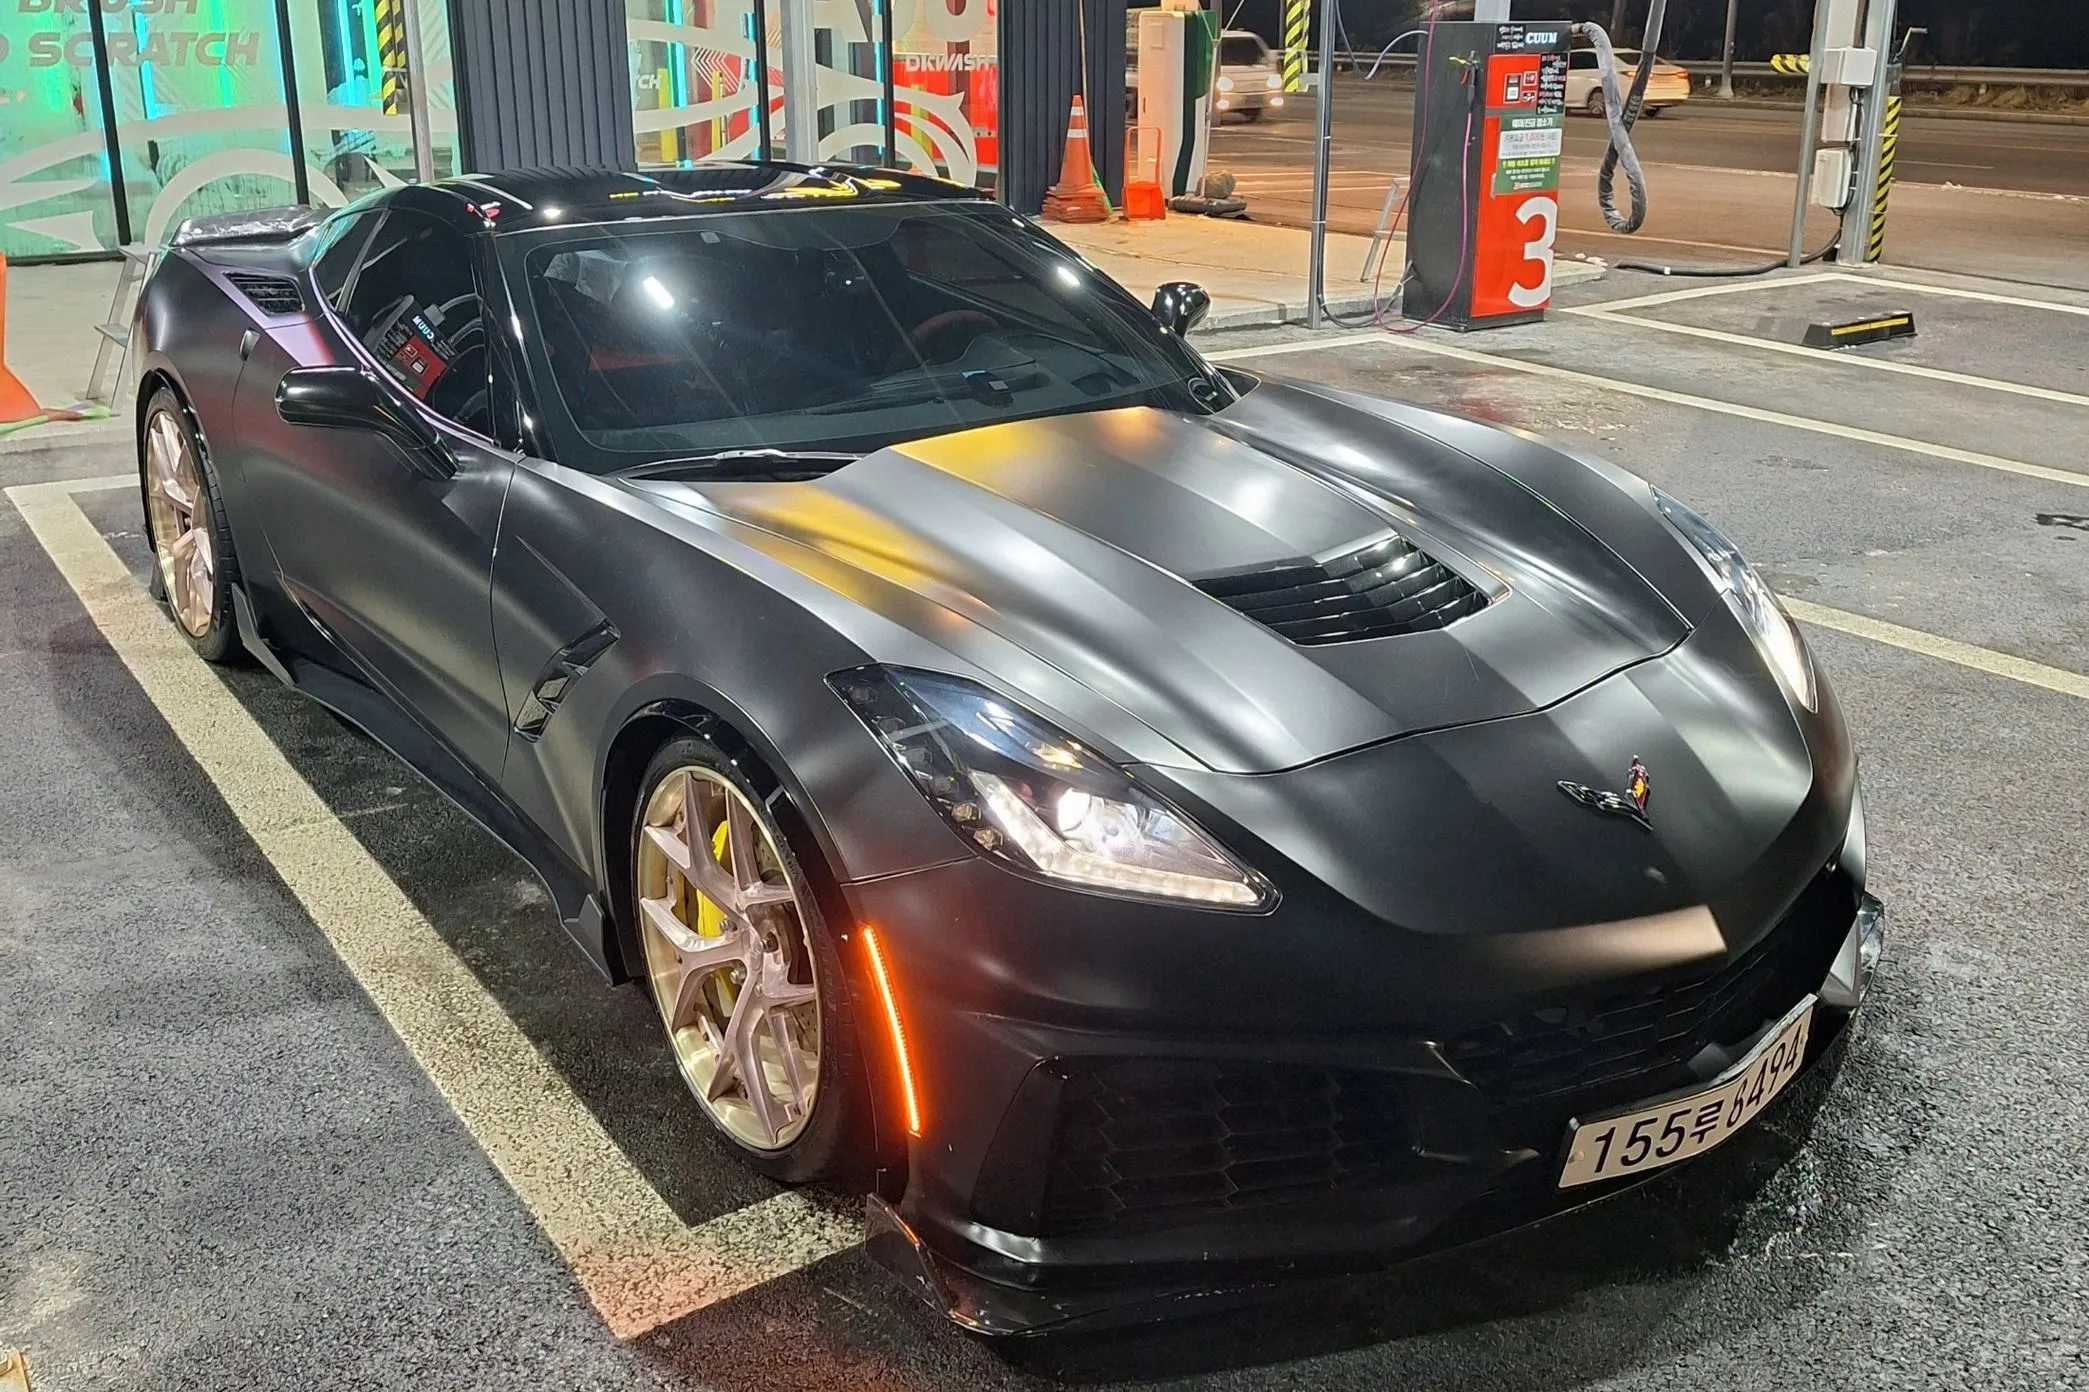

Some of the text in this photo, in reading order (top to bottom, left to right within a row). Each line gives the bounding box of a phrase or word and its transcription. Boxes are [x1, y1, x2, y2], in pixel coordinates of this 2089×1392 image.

[28, 31, 260, 68] SCRATCH
[904, 53, 993, 72] DKWASH
[1508, 196, 1558, 307] 3
[1594, 1023, 1803, 1174] 155루 6494
